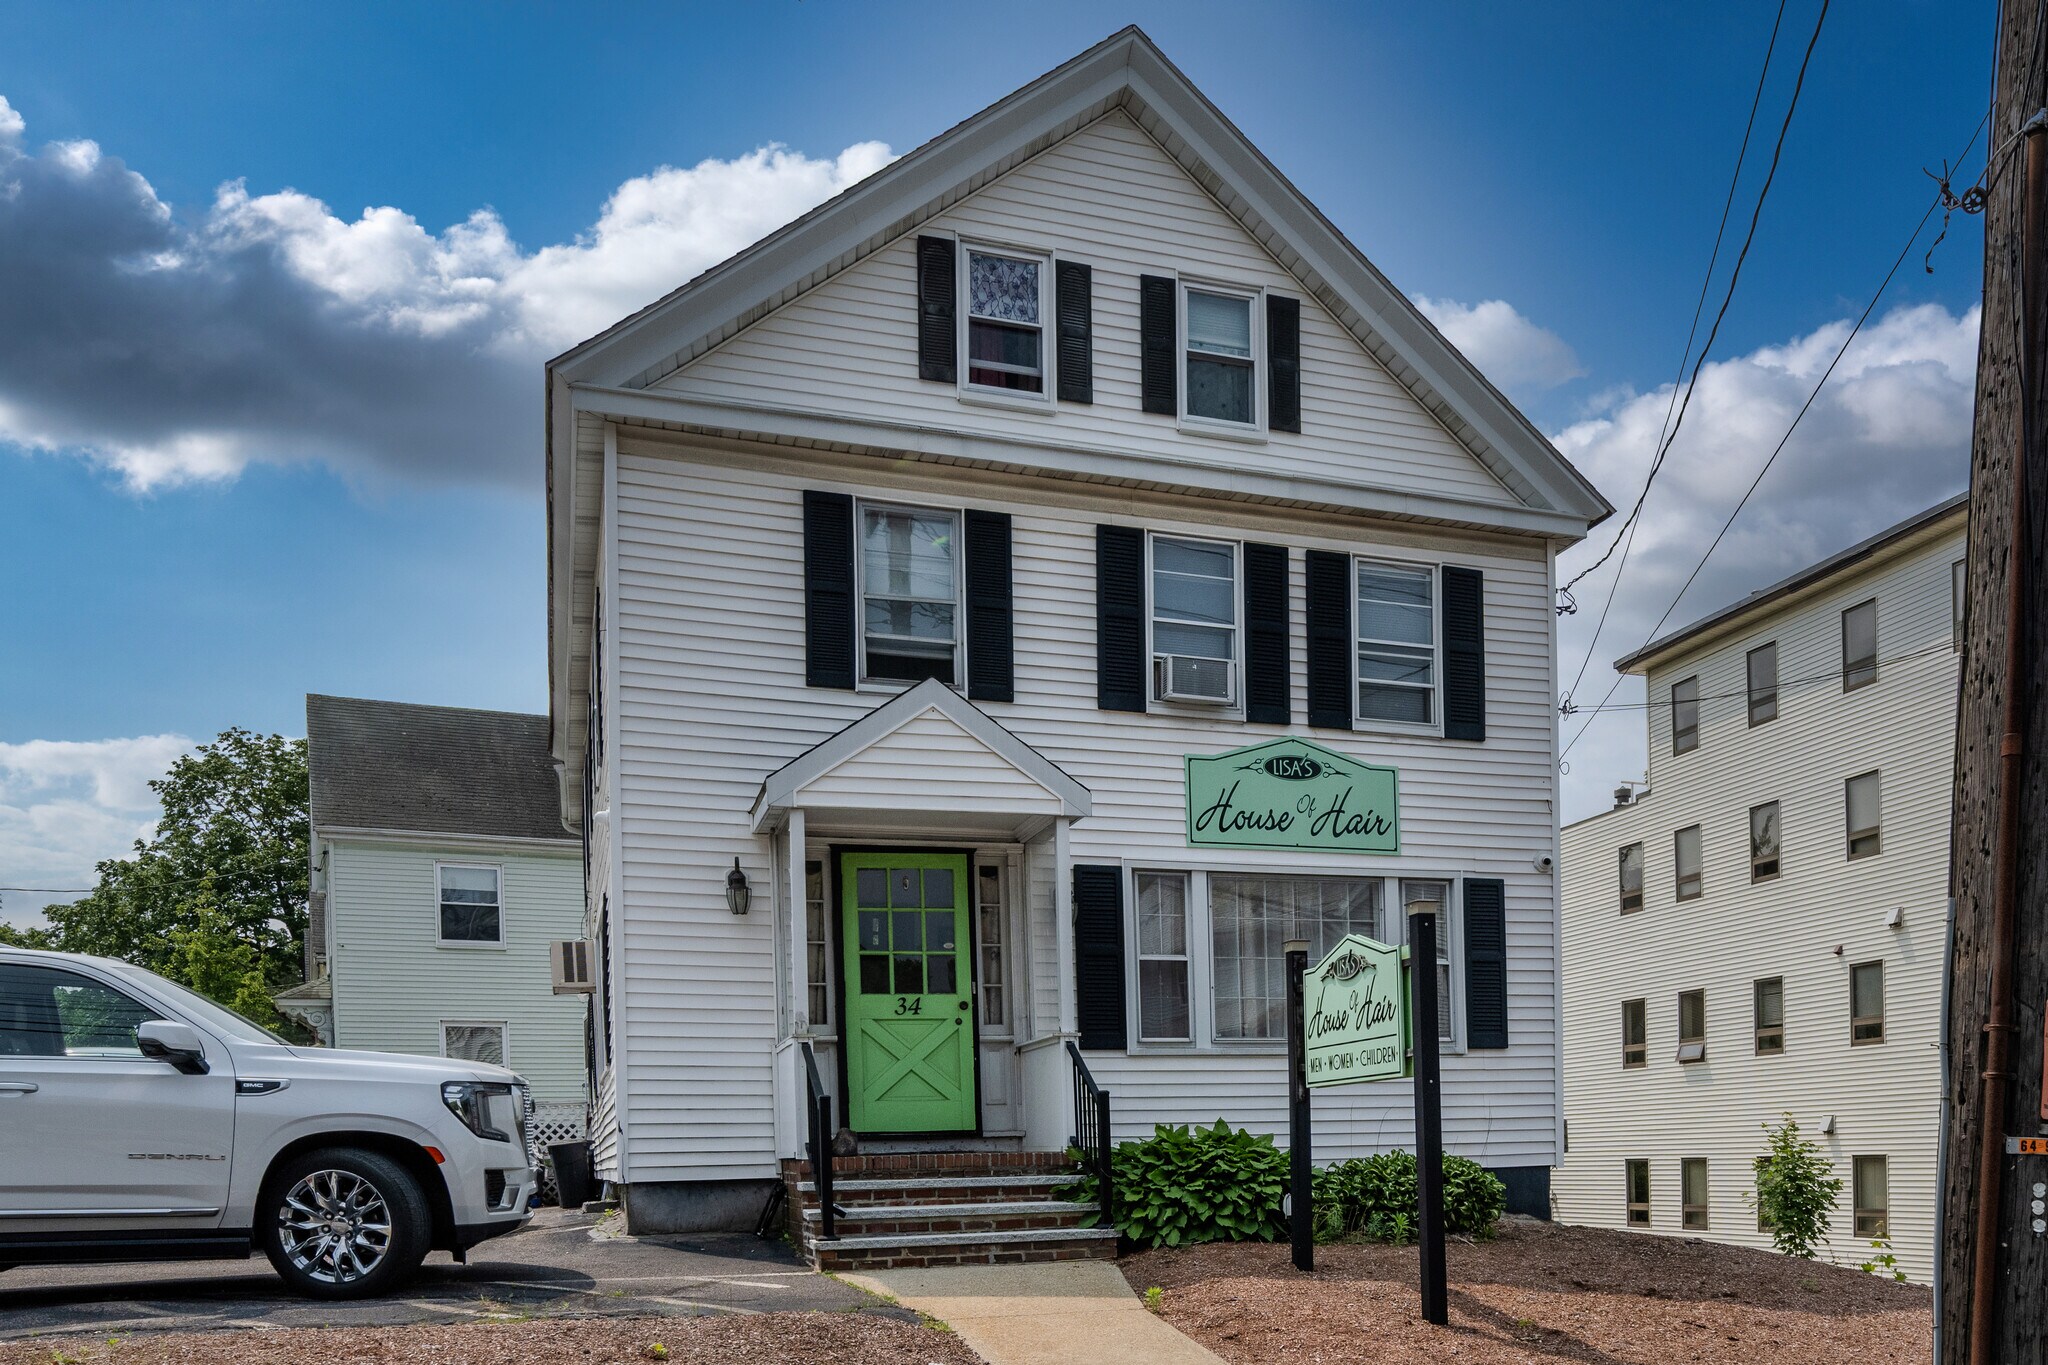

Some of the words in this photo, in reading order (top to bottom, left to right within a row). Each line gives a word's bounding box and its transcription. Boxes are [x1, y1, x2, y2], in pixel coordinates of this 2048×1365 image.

[1273, 754, 1315, 777] LISA'S
[1196, 780, 1295, 833] House
[1296, 793, 1317, 818] Of
[1310, 786, 1392, 838] Hair
[894, 996, 922, 1016] 34
[1308, 986, 1349, 1040] House
[1348, 989, 1359, 1013] Of
[1355, 974, 1397, 1031] Hair
[1310, 1057, 1322, 1074] MEN
[1328, 1052, 1353, 1070] WOMEN
[1359, 1046, 1396, 1067] CHILDREN
[127, 1153, 226, 1161] DENALI
